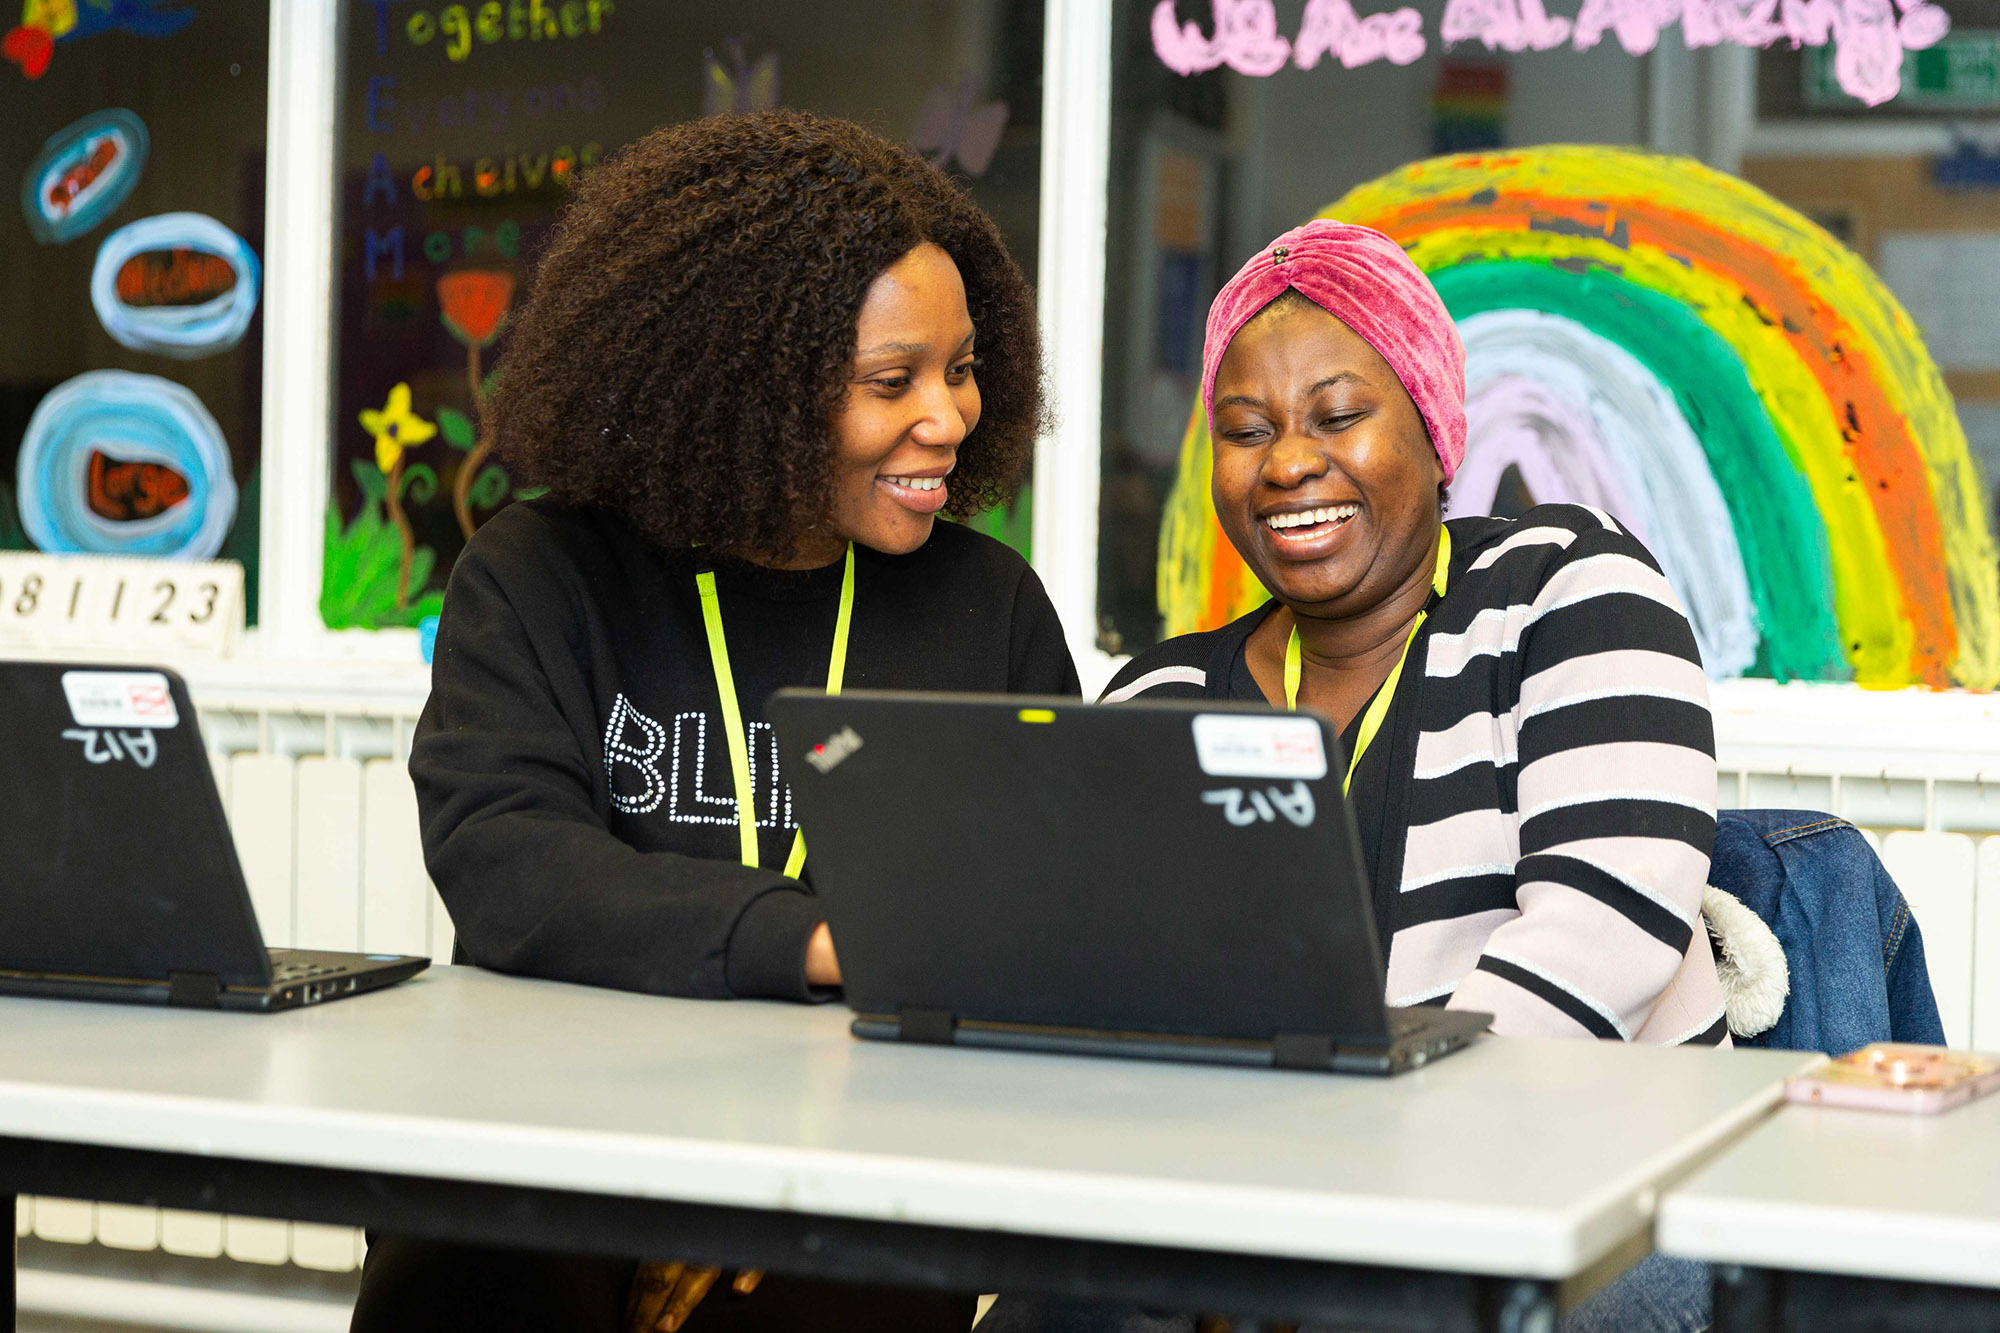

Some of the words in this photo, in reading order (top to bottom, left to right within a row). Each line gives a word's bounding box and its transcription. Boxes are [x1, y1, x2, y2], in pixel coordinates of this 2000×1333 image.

[364, 219, 520, 282] More
[0, 572, 220, 625] 81123
[61, 728, 158, 768] A12
[1201, 779, 1316, 828] A12
